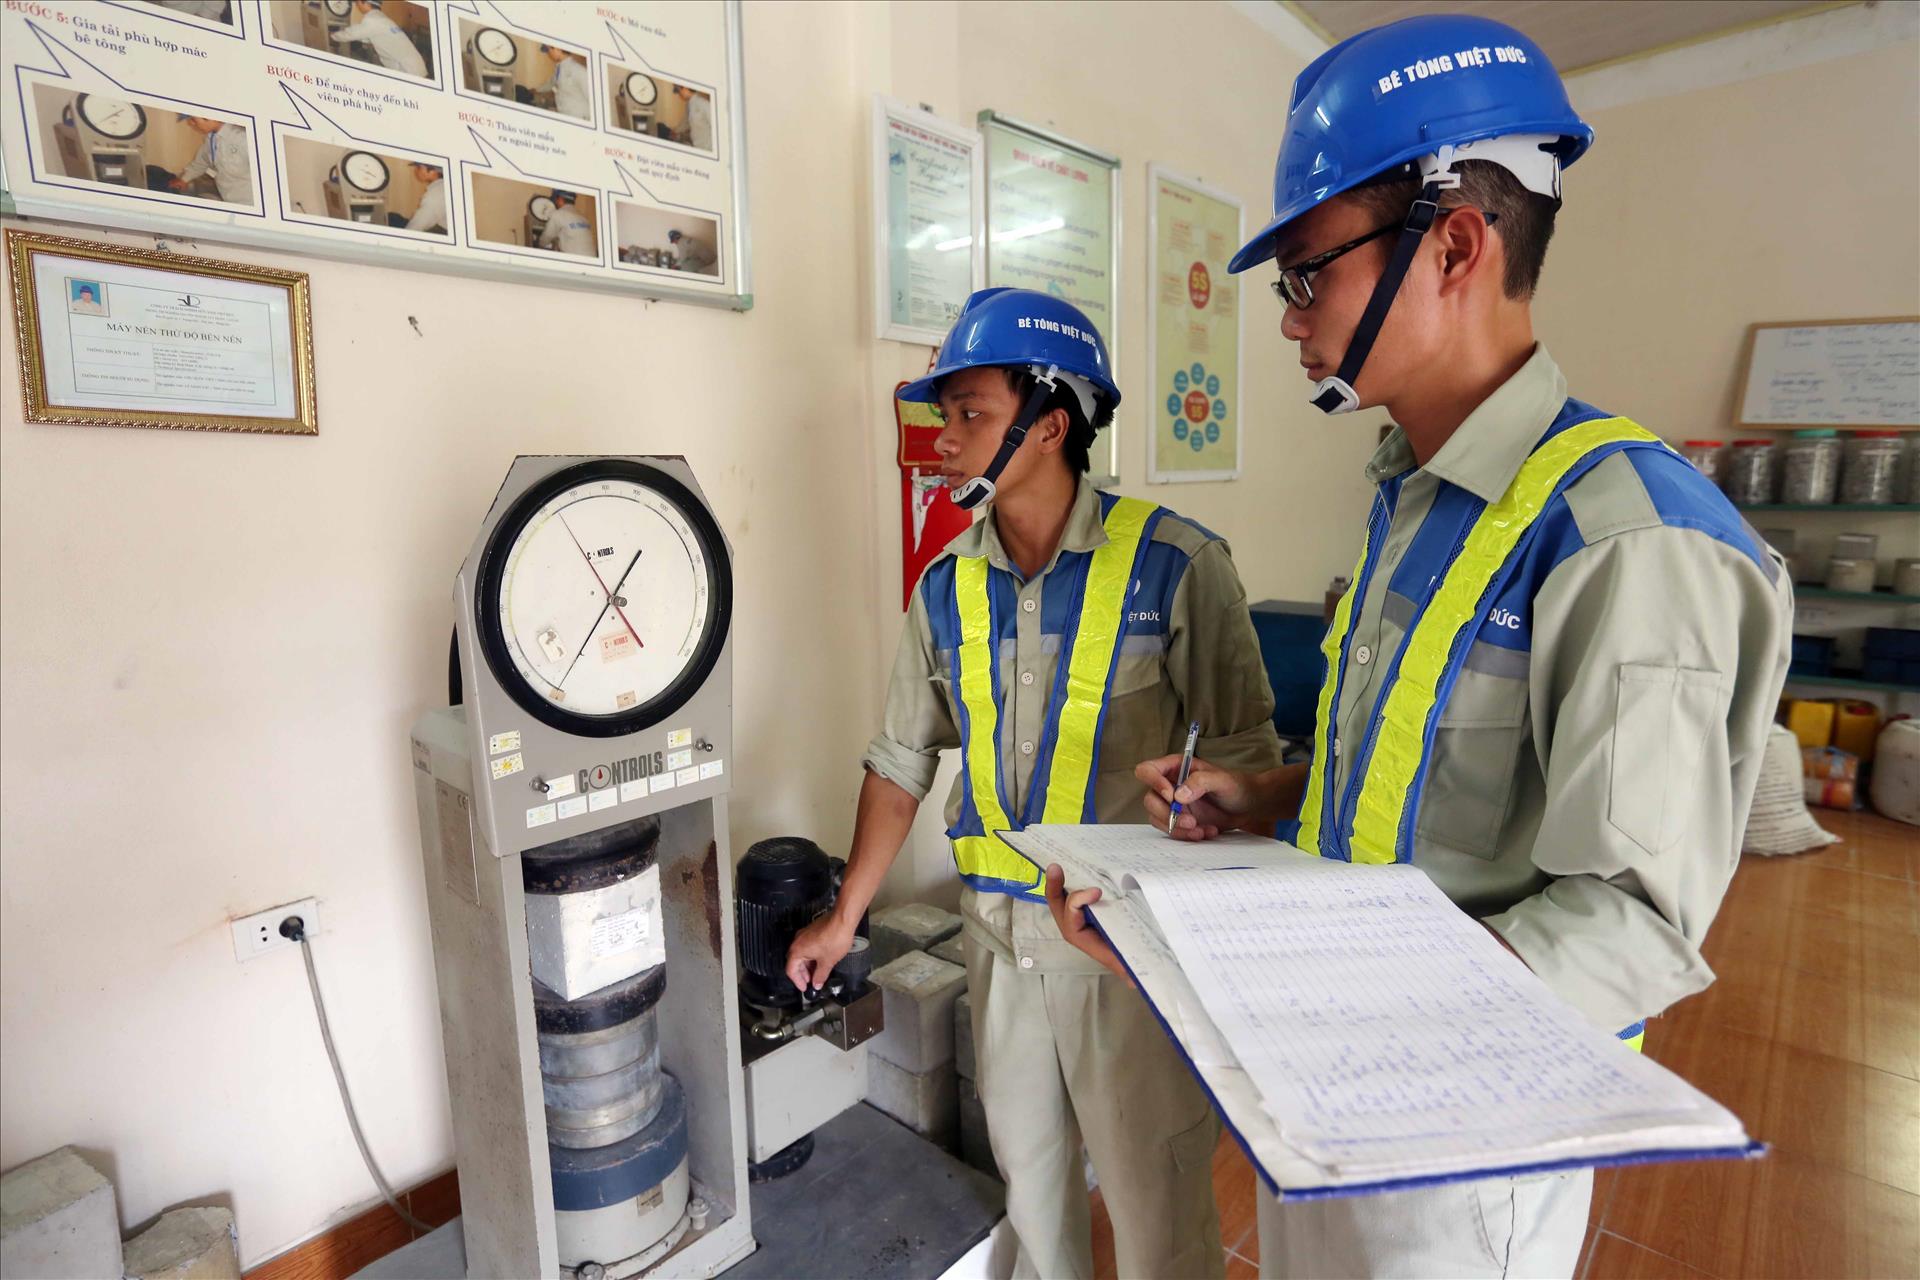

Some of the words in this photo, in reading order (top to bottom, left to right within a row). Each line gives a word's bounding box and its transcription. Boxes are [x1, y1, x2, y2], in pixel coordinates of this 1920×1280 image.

[6, 0, 52, 19] BƯỚC
[56, 12, 69, 24] 5:
[73, 16, 97, 31] Gia
[101, 22, 120, 37] tải
[125, 31, 150, 45] phù
[154, 36, 178, 53] hợp
[182, 46, 208, 59] mác
[74, 32, 91, 44] bê
[95, 38, 127, 55] tông
[1378, 70, 1402, 94] BÊ
[1404, 55, 1453, 82] TÔNG
[1454, 46, 1492, 68] VIỆT
[1494, 45, 1526, 64] ĐỨC
[266, 65, 300, 80] BƯỚC
[303, 74, 313, 84] 6:
[316, 76, 330, 88] Để
[333, 83, 354, 96] máy
[357, 88, 381, 102] chạy
[383, 93, 401, 106] đến
[404, 99, 419, 110] khi
[317, 92, 340, 104] viên
[343, 98, 362, 110] phá
[487, 119, 494, 128] 7:
[106, 321, 131, 333] MÁY
[160, 326, 184, 338] THỬ
[184, 330, 199, 341] ĐỘ
[1018, 317, 1031, 328] BÊ
[1033, 318, 1060, 332] TÔNG
[1061, 324, 1080, 339] VIỆT
[578, 751, 663, 793] CONTROLS
